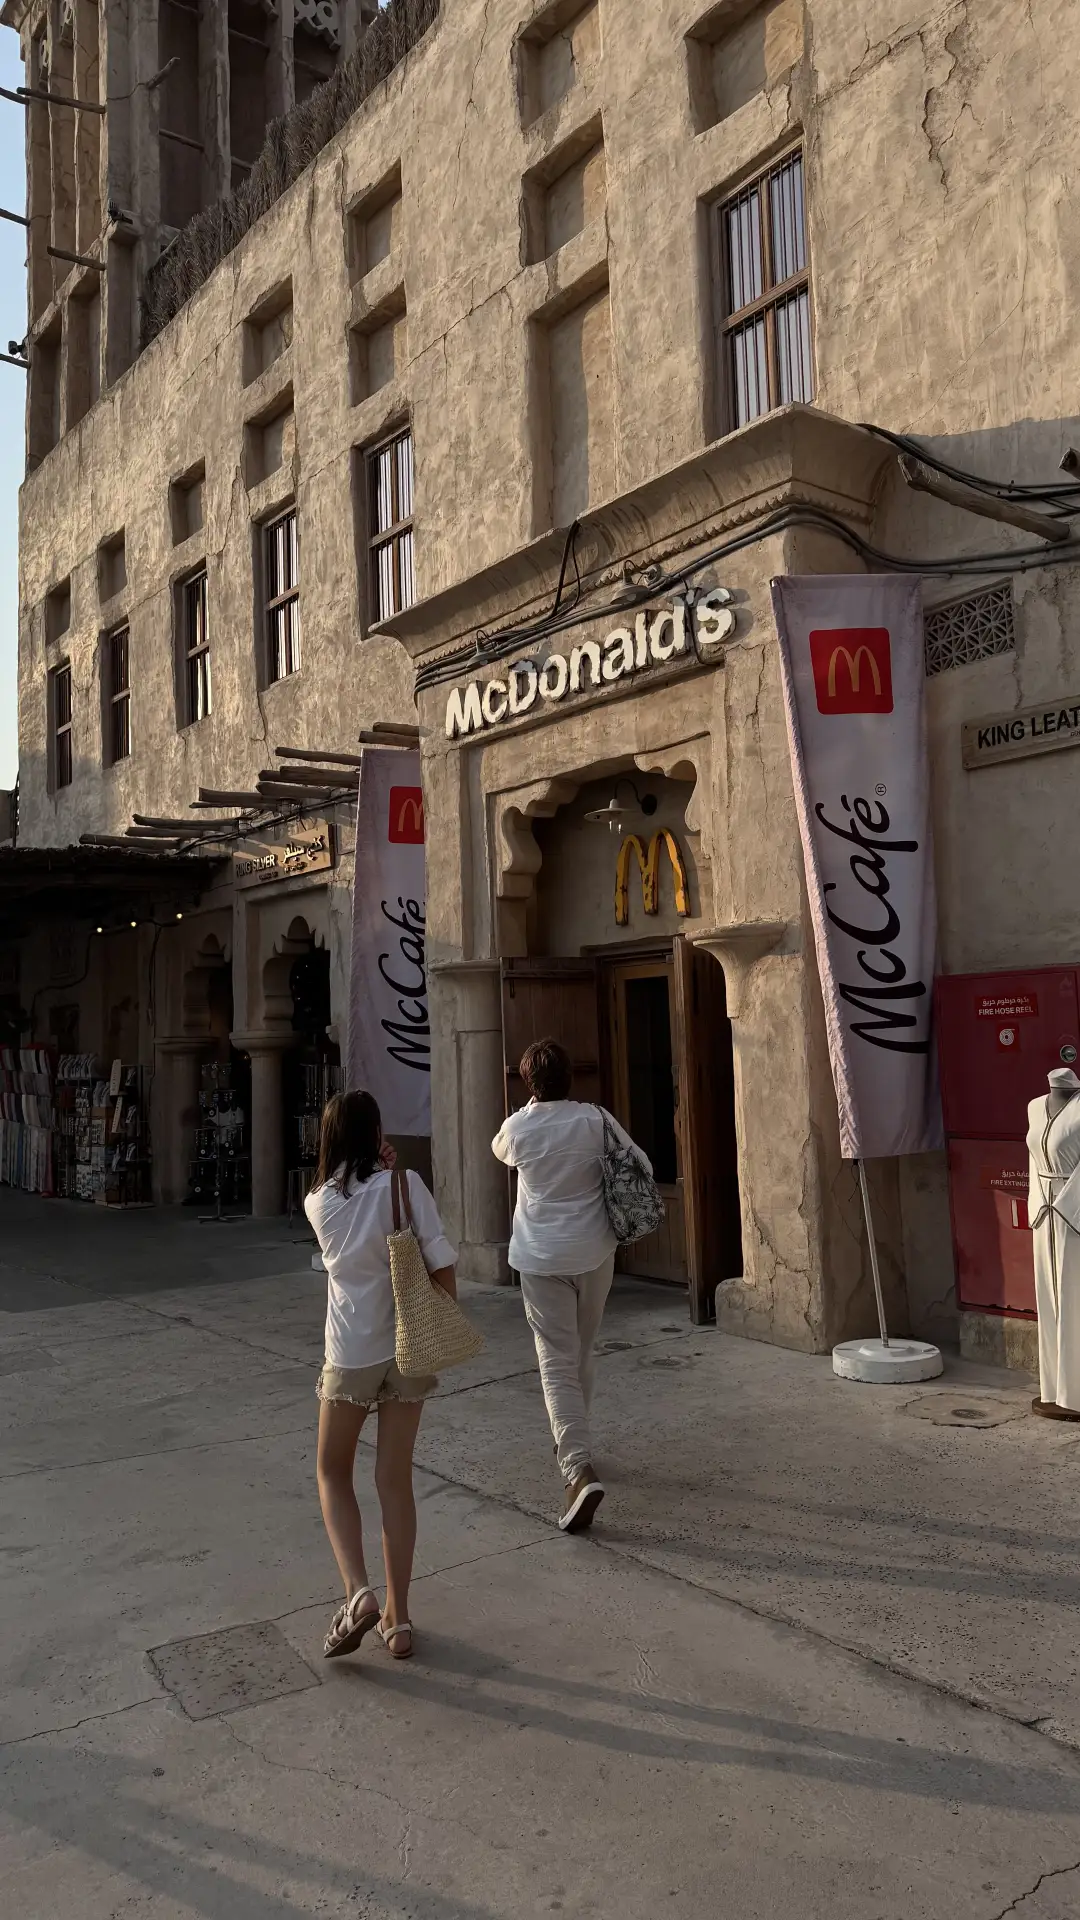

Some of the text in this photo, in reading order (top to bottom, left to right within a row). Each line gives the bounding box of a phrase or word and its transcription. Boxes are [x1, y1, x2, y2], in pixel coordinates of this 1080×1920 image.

[445, 587, 735, 738] McDonald's
[977, 705, 1080, 749] KING LEAT
[236, 861, 251, 877] KING
[252, 854, 275, 871] SILVER
[978, 1006, 1033, 1016] FIRE HOSE REEL
